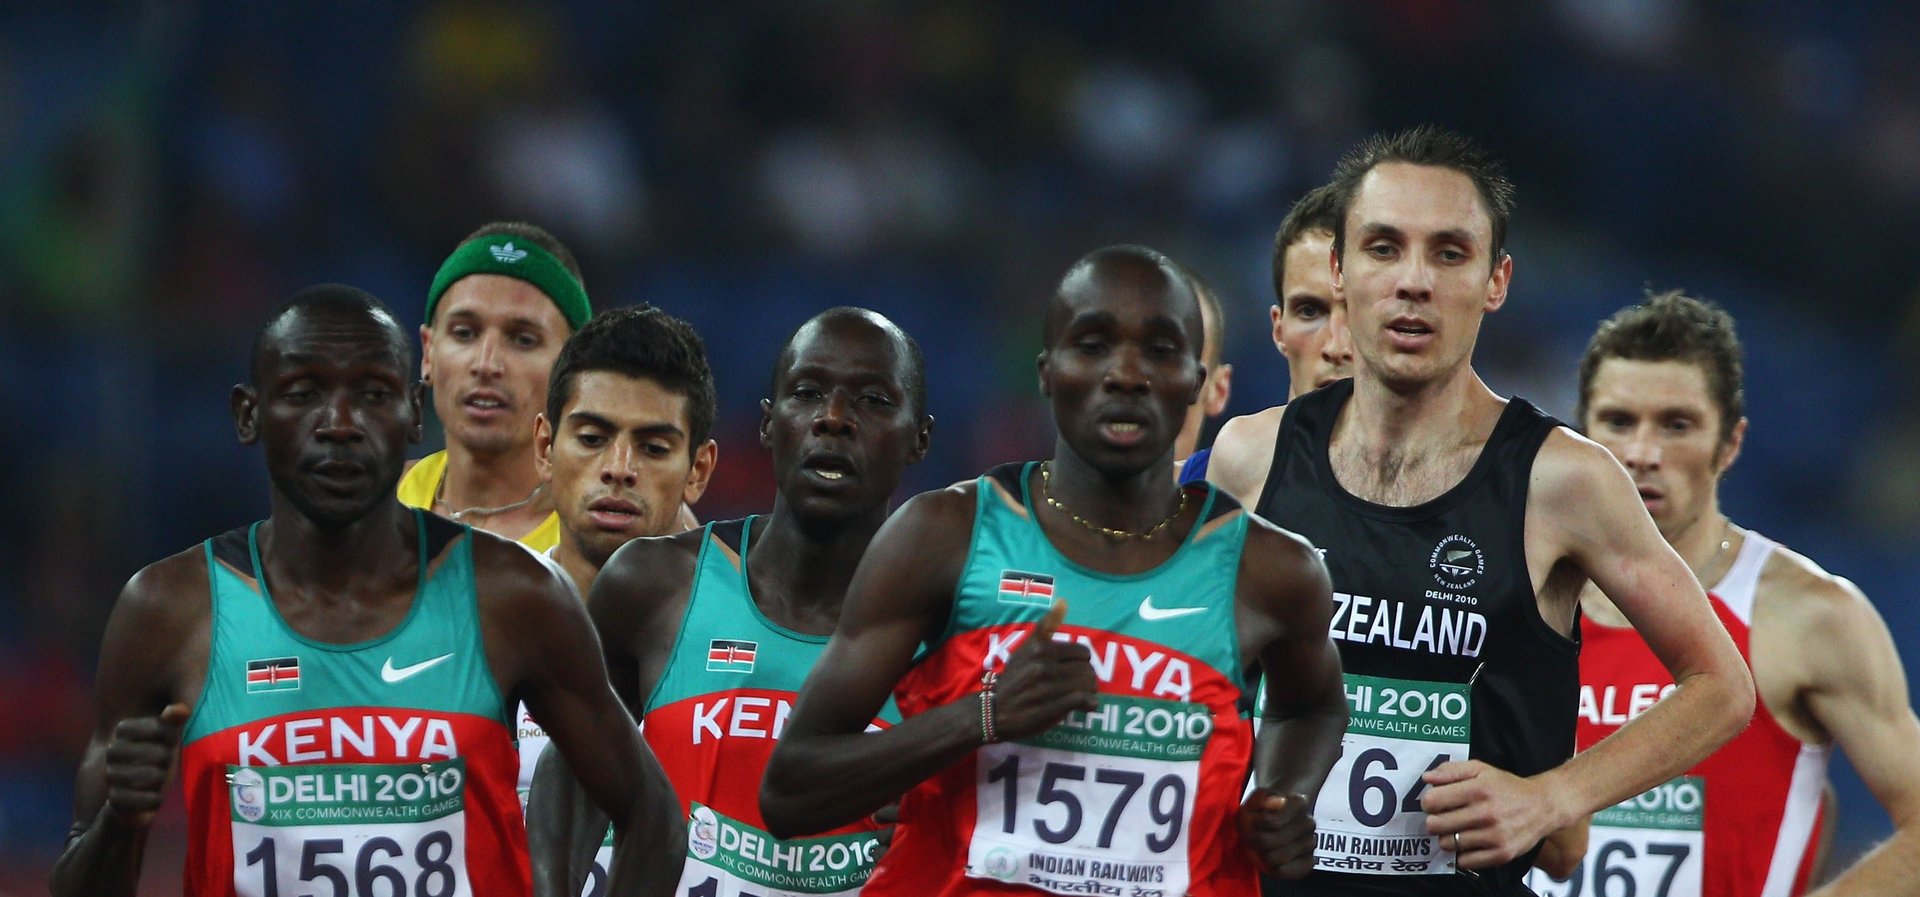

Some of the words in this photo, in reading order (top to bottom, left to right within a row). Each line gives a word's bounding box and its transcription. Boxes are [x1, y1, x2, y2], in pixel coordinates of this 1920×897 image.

[1430, 534, 1476, 568] COMMONWEALTH
[1475, 549, 1485, 575] GAMES
[1425, 589, 1453, 601] DELHI
[1454, 594, 1478, 605] 2010
[1433, 573, 1446, 586] NEW
[1446, 578, 1476, 590] ZEALAND
[1327, 592, 1487, 658] ZEALAND
[983, 630, 1193, 703] KNYA
[1377, 688, 1467, 720] 2010
[1123, 706, 1214, 740] 2010
[1421, 724, 1466, 737] GAMES
[238, 715, 458, 768] KENYA
[1166, 743, 1200, 755] GAMES
[268, 774, 367, 802] DELHI
[374, 768, 461, 801] 2010
[1616, 783, 1700, 812] 010
[270, 808, 292, 821] XIX
[296, 806, 418, 820] COMMONWEALTH
[422, 797, 460, 815] GAMES
[987, 754, 1187, 854] 1579
[720, 822, 803, 872] DELHI
[1350, 836, 1431, 857] RAILWAYS
[245, 830, 457, 897] 1568
[719, 853, 735, 869] XIX
[738, 863, 846, 889] COMMONWEALTH
[1029, 852, 1086, 877] INDIAN
[1089, 861, 1164, 883] RAILWAYS
[1391, 858, 1431, 872] रेल
